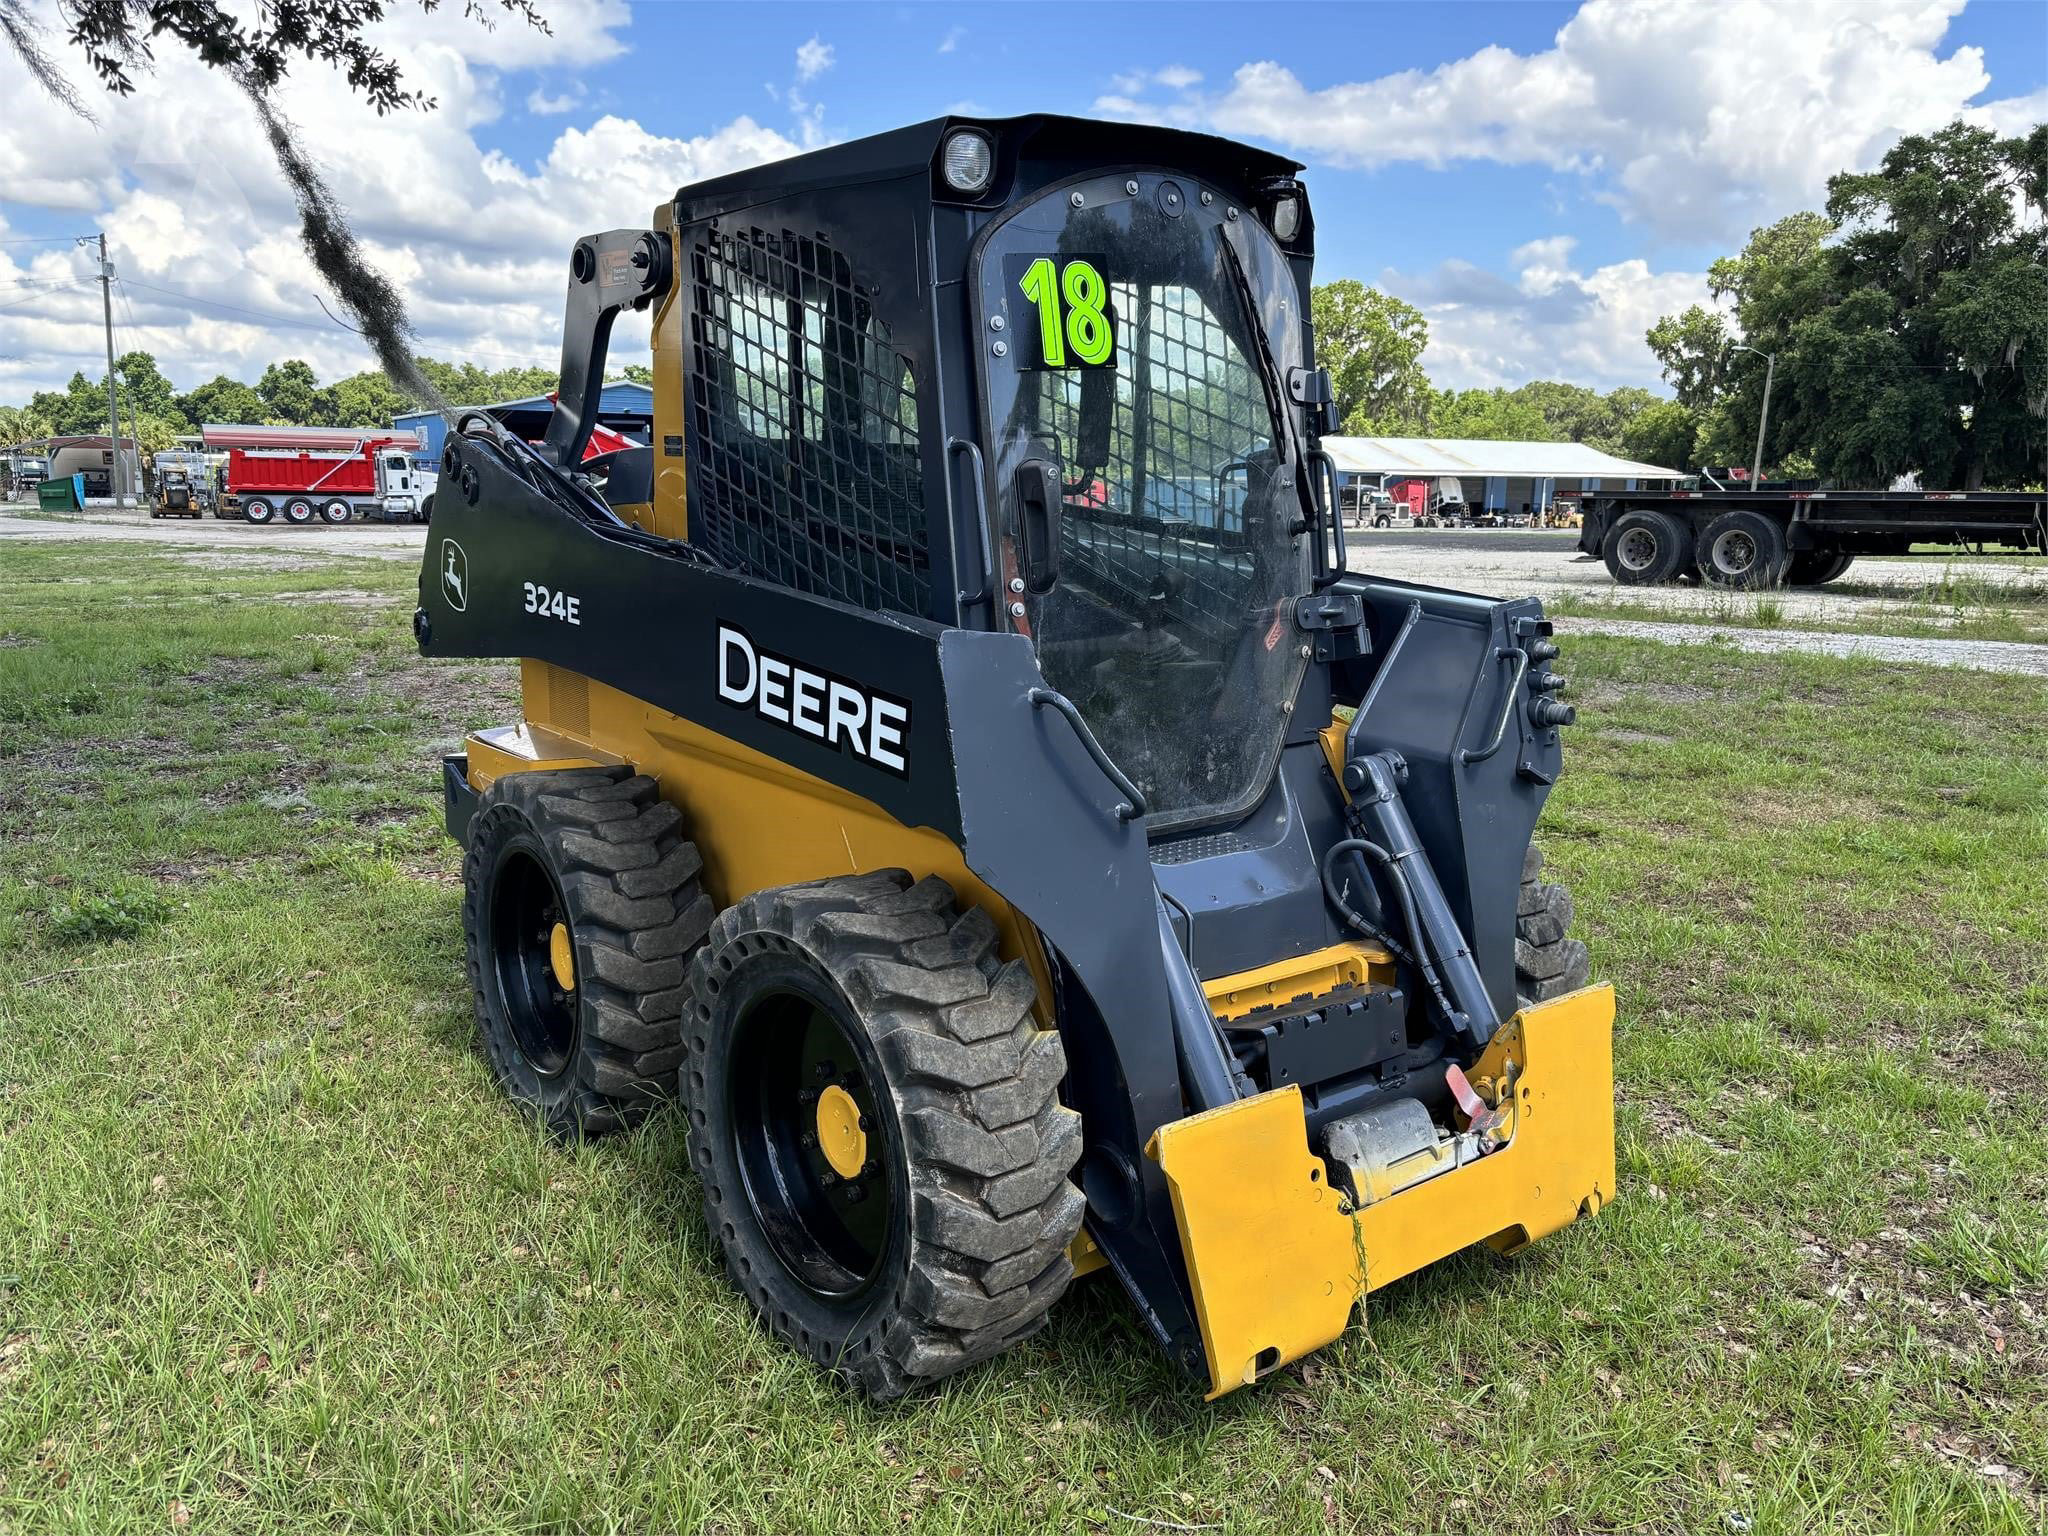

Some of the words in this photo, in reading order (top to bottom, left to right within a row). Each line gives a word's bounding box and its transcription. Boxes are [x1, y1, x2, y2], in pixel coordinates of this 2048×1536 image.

[1019, 258, 1112, 366] 18
[523, 581, 581, 626] 324E
[719, 626, 907, 771] DEERE
